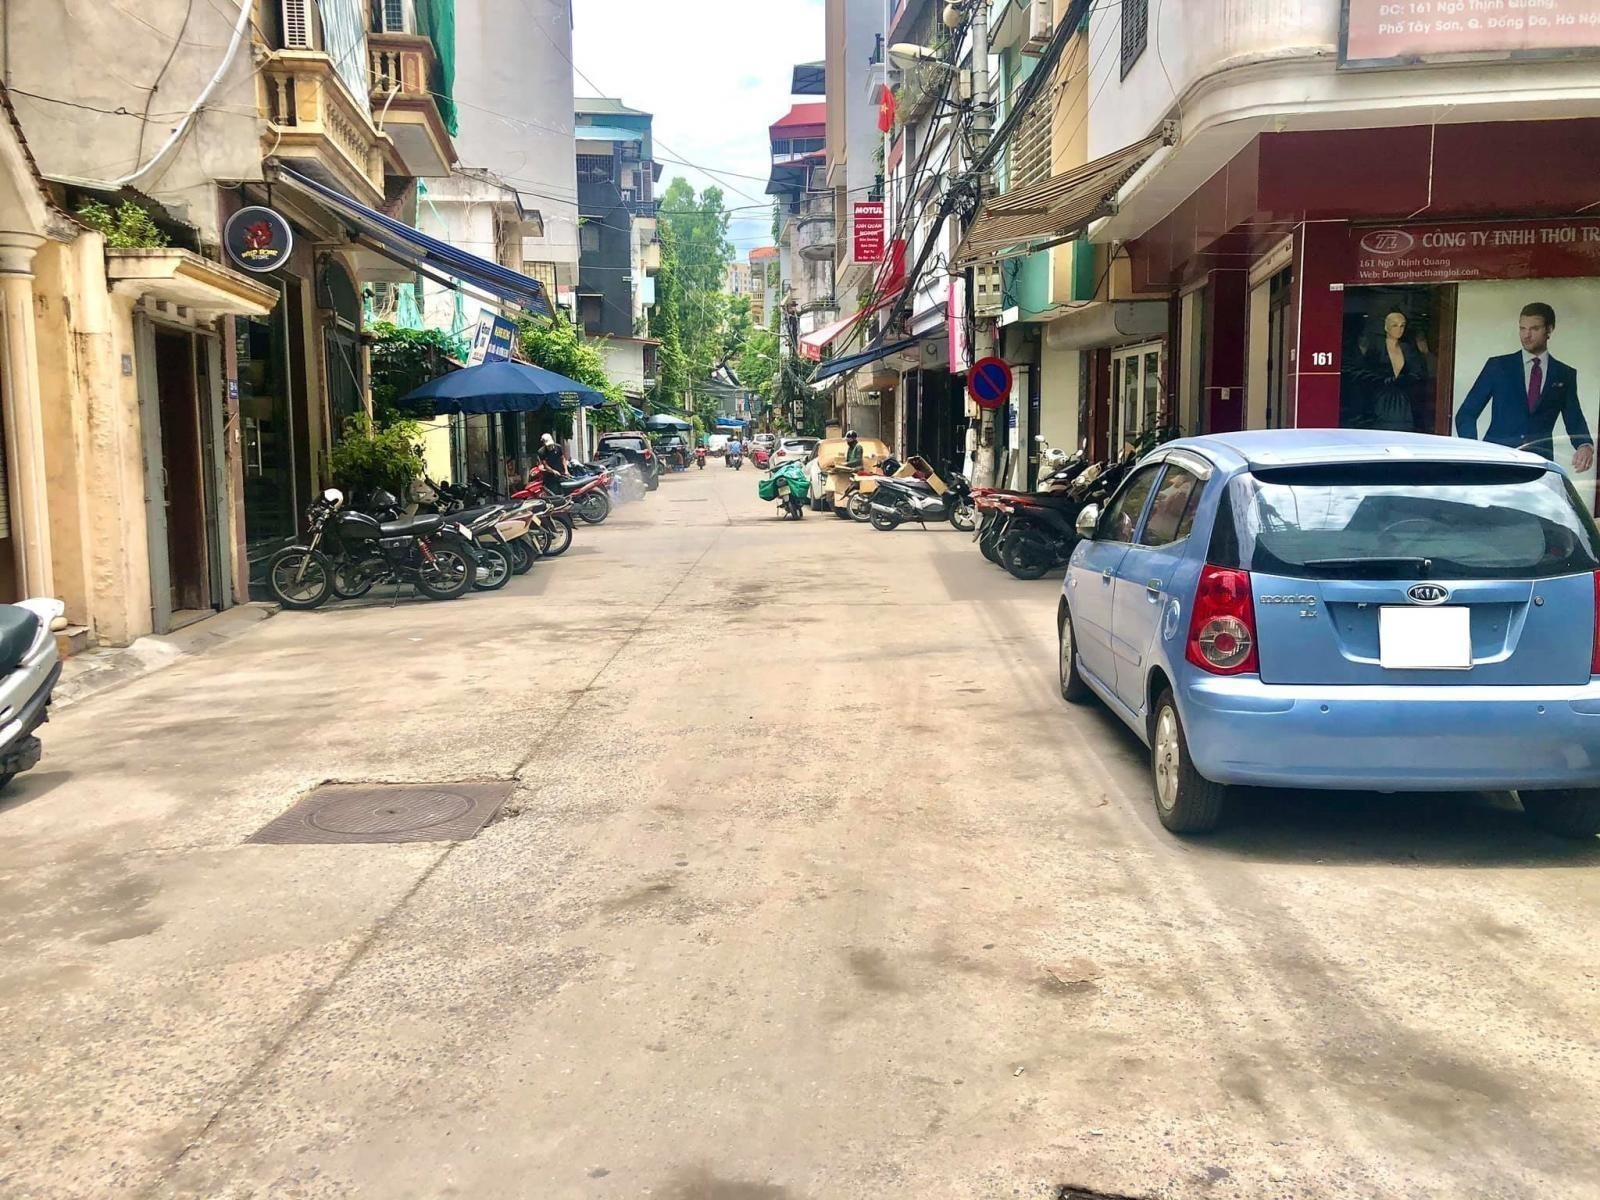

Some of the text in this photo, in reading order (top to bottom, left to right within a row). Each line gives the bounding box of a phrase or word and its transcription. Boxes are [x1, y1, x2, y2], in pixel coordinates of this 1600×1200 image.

[1410, 2, 1431, 14] 161
[1378, 19, 1404, 35] Phố
[1408, 20, 1430, 35] Tây
[1468, 18, 1483, 29] Q.
[1423, 229, 1466, 248] CÔNG
[1471, 231, 1490, 247] TY
[1493, 230, 1535, 246] TNHH
[1360, 260, 1376, 268] 161
[1423, 257, 1451, 267] Quang
[1359, 271, 1381, 279] Web:
[1312, 352, 1333, 366] 161
[1260, 594, 1317, 606] morning
[1414, 588, 1441, 600] KIA
